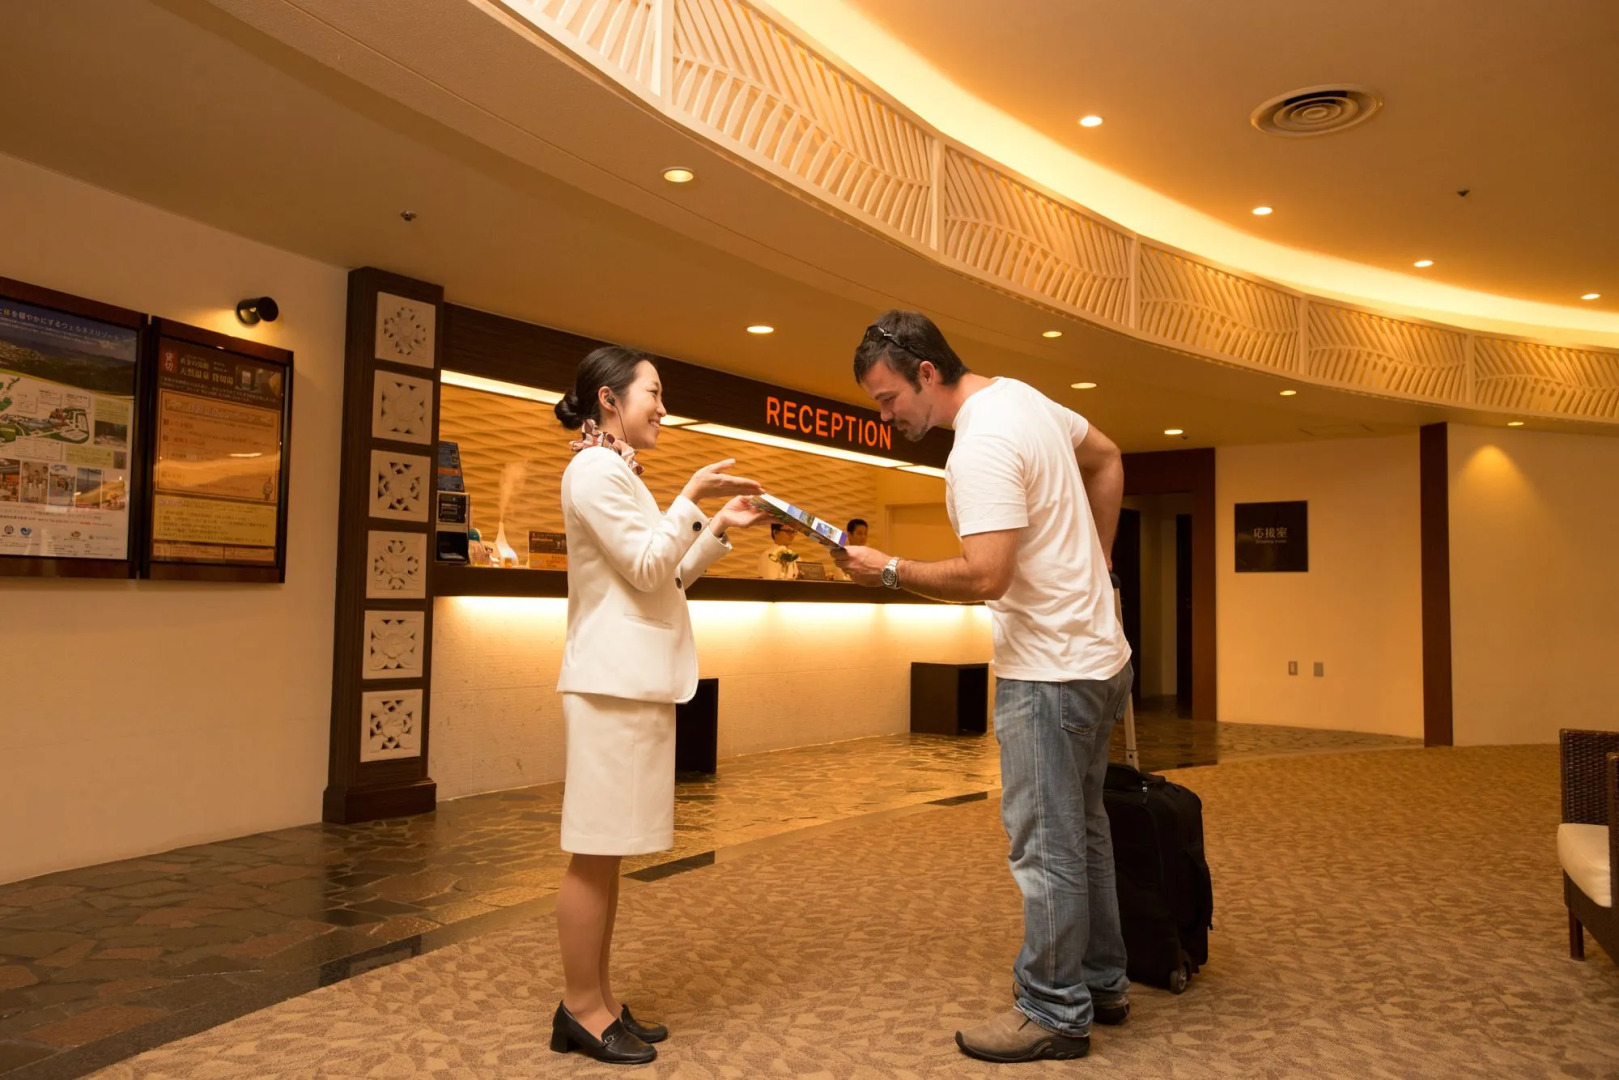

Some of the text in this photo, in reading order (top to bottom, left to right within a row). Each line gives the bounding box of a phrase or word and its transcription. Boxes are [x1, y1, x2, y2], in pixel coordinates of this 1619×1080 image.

[767, 396, 891, 450] RECEPTION
[1253, 527, 1288, 539] 応接室
